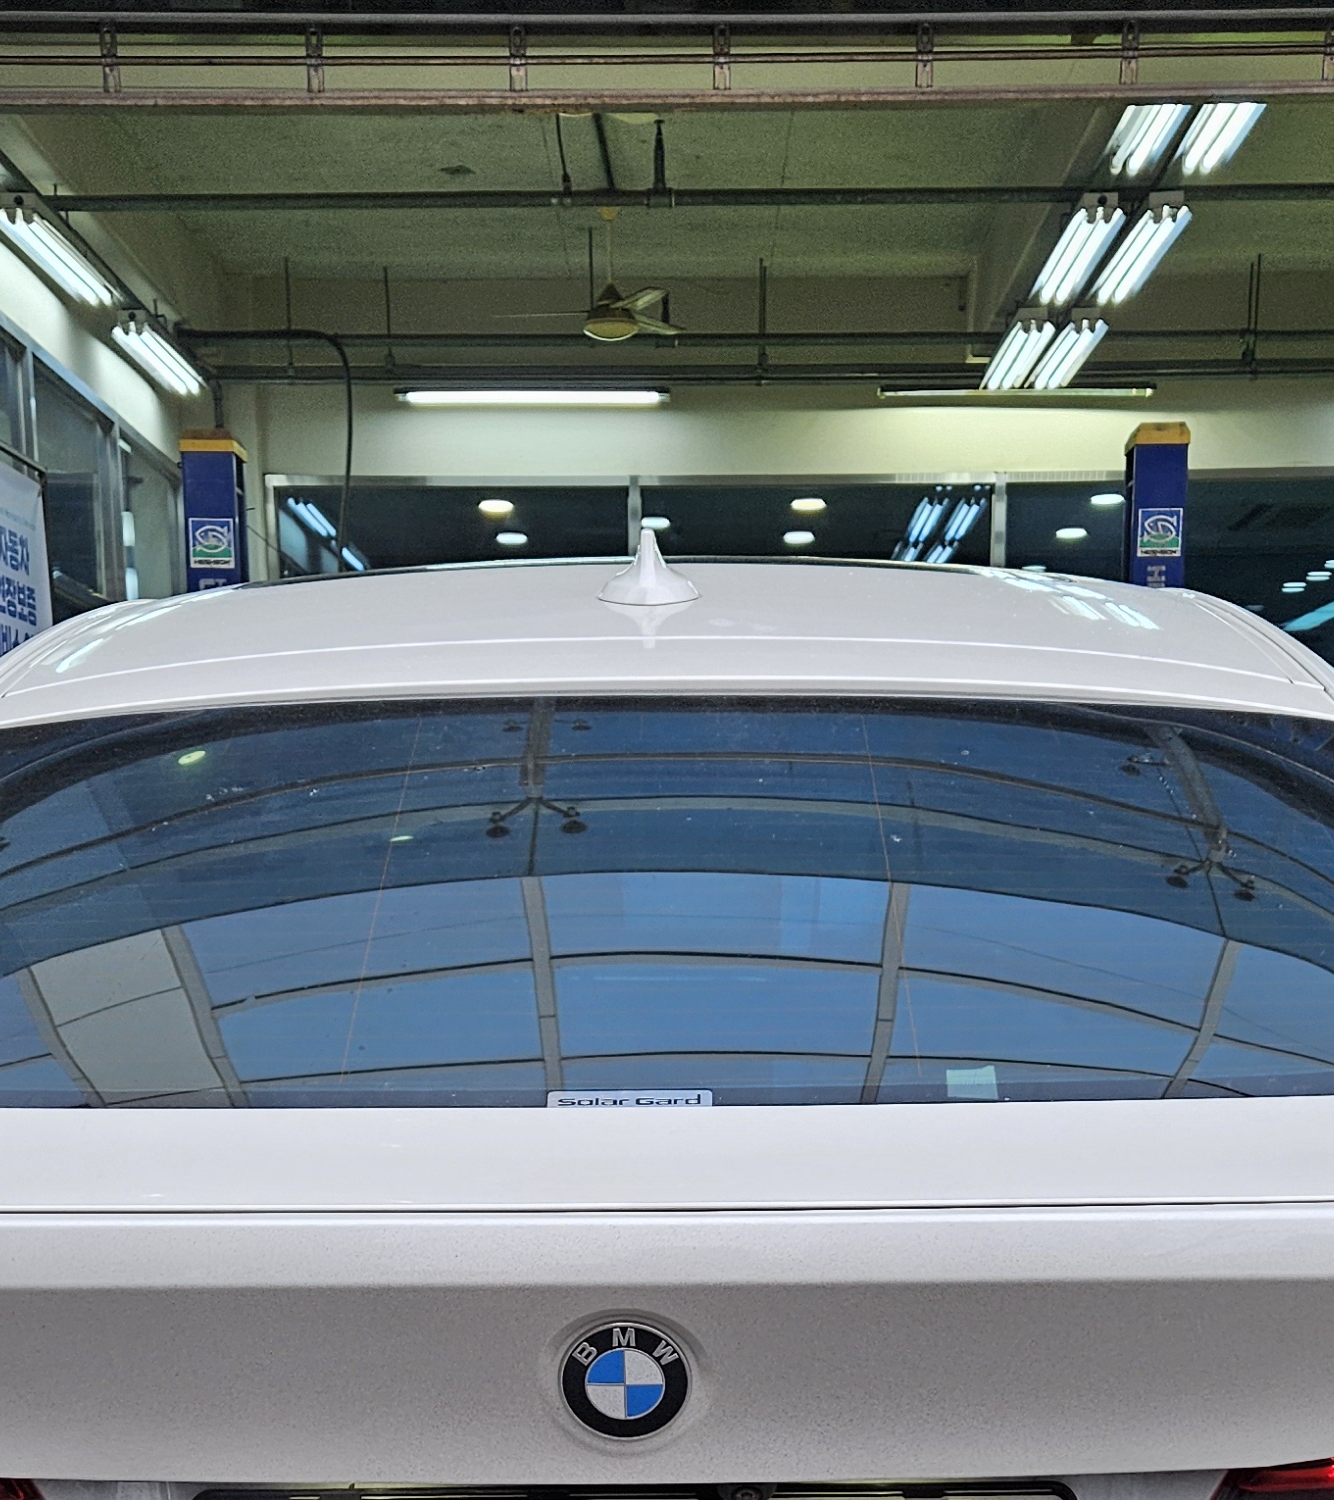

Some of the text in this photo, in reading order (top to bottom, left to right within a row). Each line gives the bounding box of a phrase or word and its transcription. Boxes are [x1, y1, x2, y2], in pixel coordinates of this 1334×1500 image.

[557, 1094, 702, 1106] Solar Gard
[572, 1327, 679, 1366] BMW
